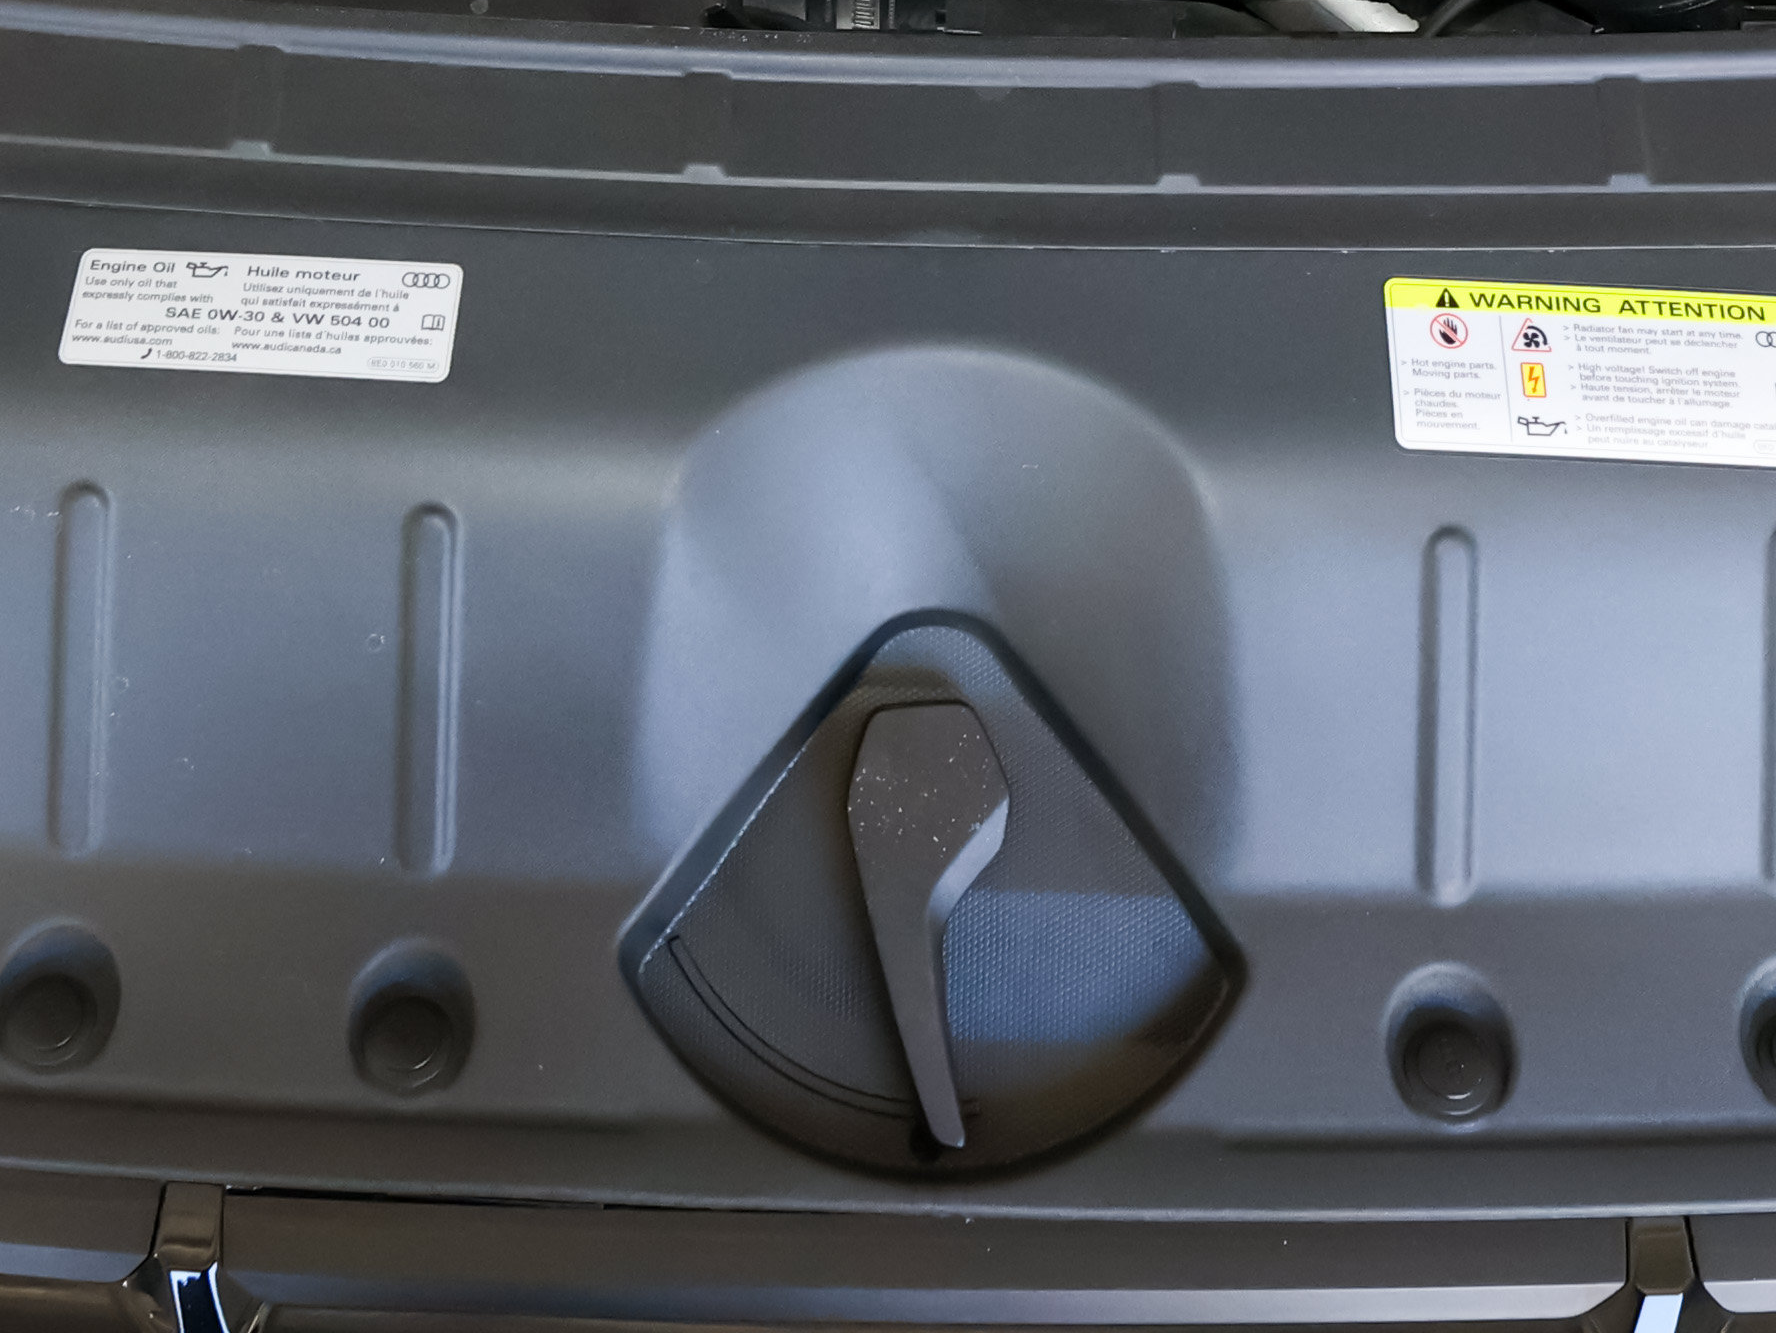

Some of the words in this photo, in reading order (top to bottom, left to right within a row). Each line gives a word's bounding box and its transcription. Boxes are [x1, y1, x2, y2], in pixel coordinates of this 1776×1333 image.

[90, 260, 147, 273] Engine
[153, 262, 175, 273] Oil
[247, 265, 290, 278] Huile
[295, 269, 360, 282] moteur
[85, 276, 107, 286] Use
[110, 279, 134, 288] only
[137, 279, 153, 288] oil
[155, 279, 177, 288] that
[243, 282, 283, 293] Utilisez
[286, 286, 355, 298] uniquement
[358, 288, 372, 298] de
[82, 291, 134, 301] expressly
[137, 292, 186, 303] complies
[190, 294, 213, 303] with
[241, 297, 259, 307] qui
[262, 297, 306, 308] satisfait
[309, 300, 389, 313] expressément
[1469, 292, 1601, 313] WARNING
[1618, 300, 1765, 321] ATTENTION
[165, 307, 202, 319] SAE
[208, 309, 265, 322] 0W-30
[271, 312, 284, 323] &
[292, 312, 325, 325] VW
[330, 315, 362, 327] 504
[368, 317, 390, 329] 00
[75, 319, 93, 328] For
[106, 320, 122, 330] list
[126, 321, 137, 331] of
[140, 323, 194, 336] approved
[197, 325, 220, 335] oils:
[233, 325, 260, 337] Pour
[264, 328, 284, 338] une
[289, 328, 312, 339] liste
[1573, 324, 1615, 333] Radiator
[1618, 325, 1633, 334] fan
[1637, 327, 1657, 336] may
[1661, 328, 1683, 337] start
[1686, 329, 1696, 337] at
[1699, 331, 1716, 339] any
[72, 333, 173, 346] www.audiusa.com
[1574, 334, 1587, 342] Le
[1589, 335, 1642, 344] ventilateur
[1645, 337, 1667, 347] peut
[231, 341, 342, 355] www.audicanada.ca
[1584, 345, 1605, 353] tout
[157, 350, 237, 362] 1-800-822-2834
[1411, 358, 1429, 367] Hot
[1432, 361, 1465, 370] engine
[1412, 368, 1451, 379] Moving
[1578, 363, 1601, 374] High
[1649, 366, 1683, 375] Switch
[1685, 368, 1698, 376] off
[1702, 370, 1736, 379] engine
[1579, 373, 1612, 382] before
[1615, 374, 1659, 385] touching
[1662, 376, 1699, 386] ignition
[1413, 387, 1446, 398] Pièces
[1449, 389, 1462, 398] du
[1465, 391, 1501, 400] moteur
[1581, 383, 1610, 392] Haute
[1693, 388, 1701, 396] le
[1704, 389, 1740, 398] moteur
[1582, 393, 1609, 402] avant
[1613, 394, 1625, 402] de
[1628, 395, 1665, 404] toucher
[1638, 417, 1672, 427] engine
[1675, 417, 1687, 426] oil
[1690, 419, 1708, 427] can
[1711, 420, 1751, 431] damage
